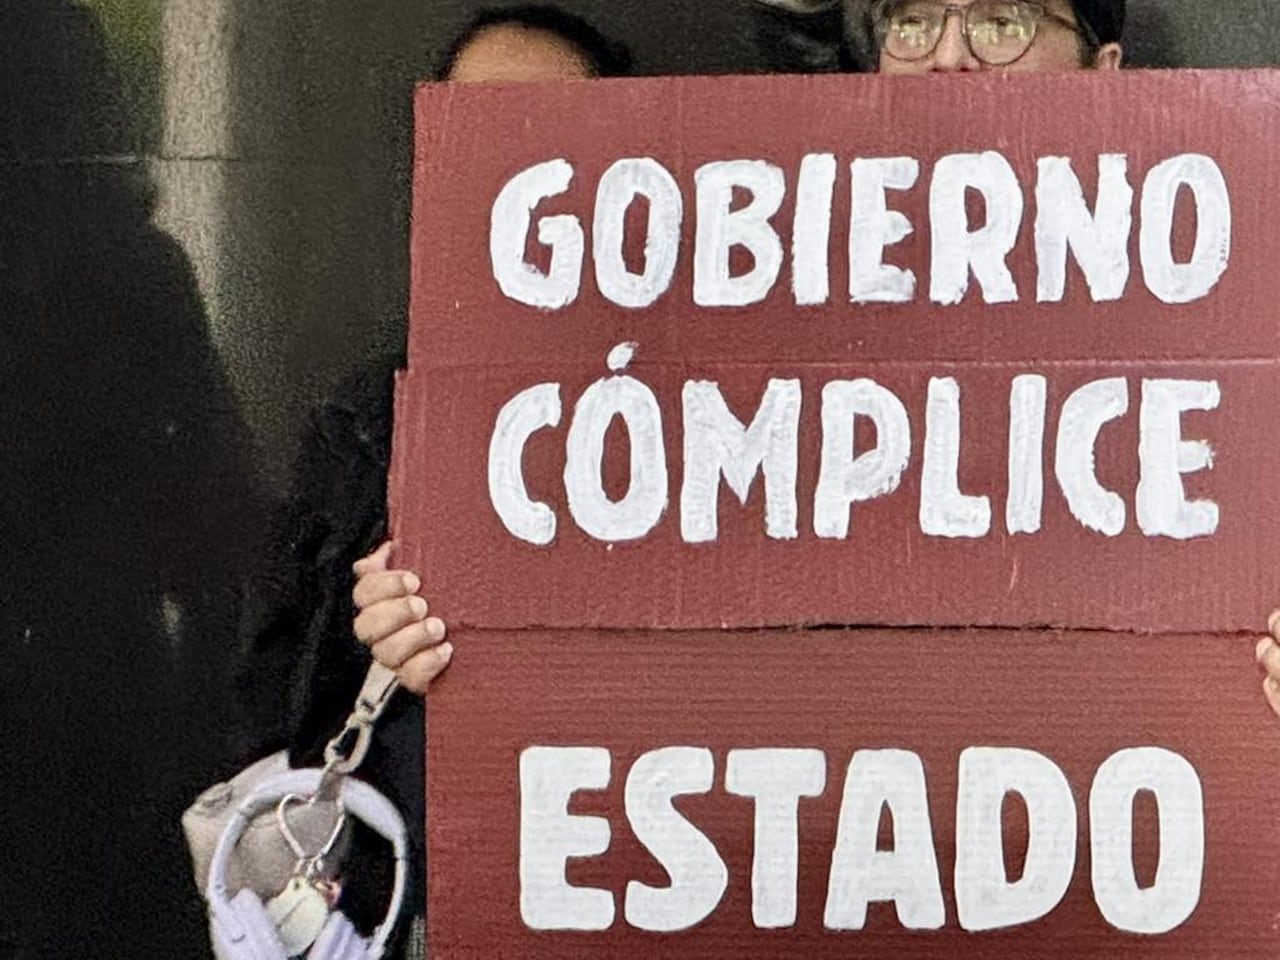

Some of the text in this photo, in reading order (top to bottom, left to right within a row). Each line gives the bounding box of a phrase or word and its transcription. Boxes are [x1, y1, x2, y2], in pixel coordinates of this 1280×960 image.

[489, 149, 1232, 311] GOBIERNO
[487, 341, 1223, 546] CÓMPLICE
[518, 745, 1206, 935] ESTADO
